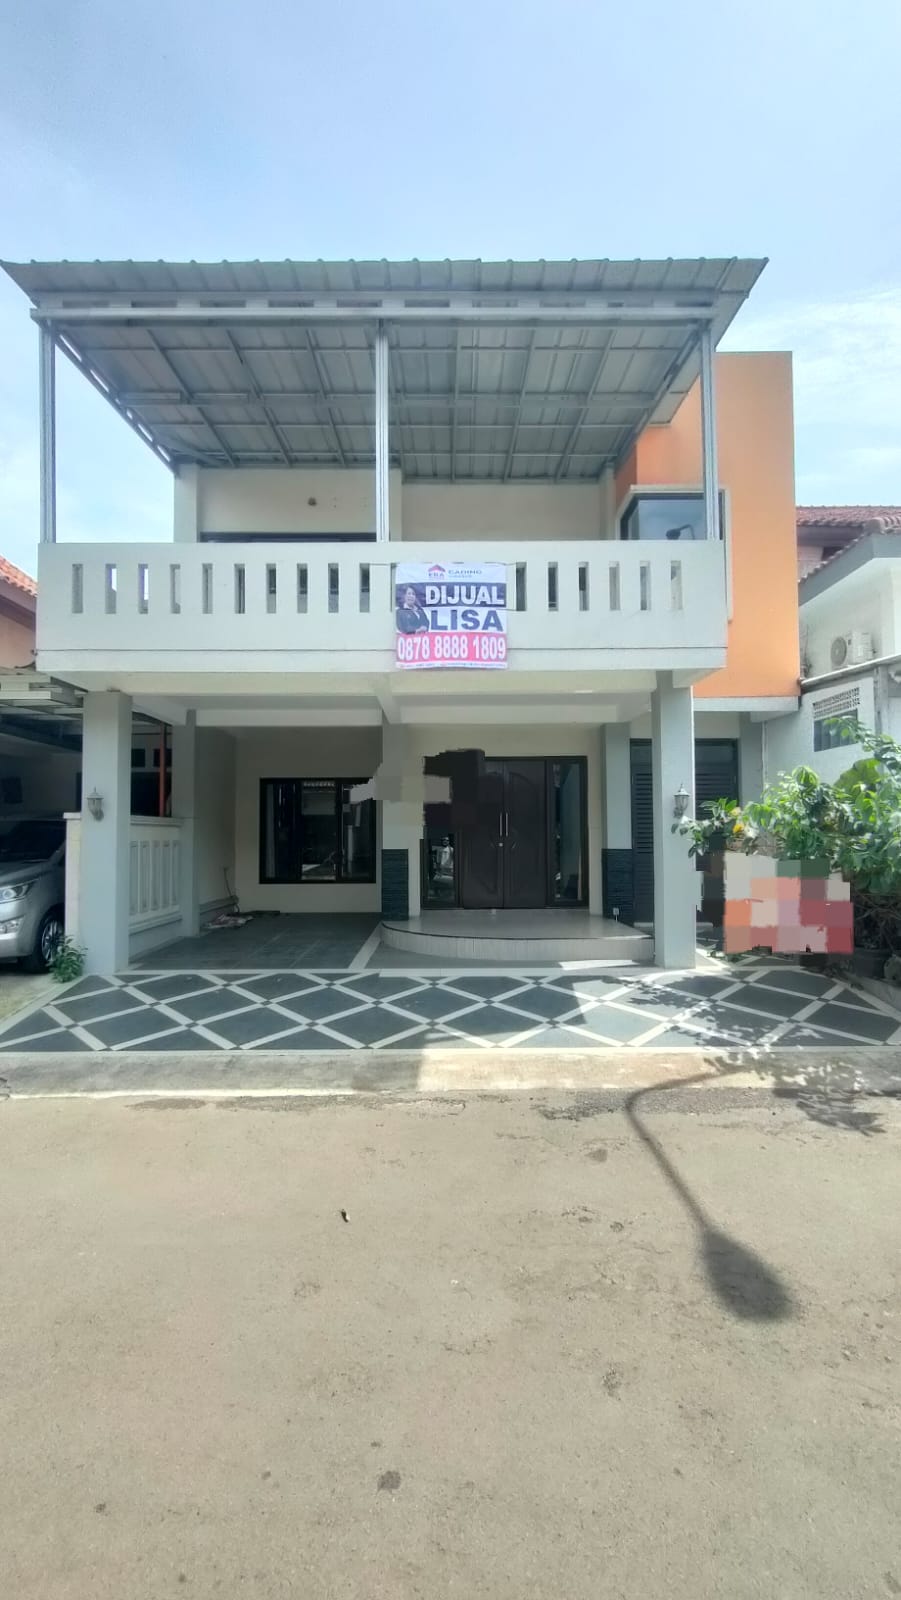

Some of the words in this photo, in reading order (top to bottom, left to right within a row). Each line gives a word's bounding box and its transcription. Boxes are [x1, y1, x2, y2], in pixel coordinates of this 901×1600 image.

[425, 585, 505, 605] DIJUAL
[430, 609, 504, 631] LISA
[397, 636, 430, 661] 0878
[434, 635, 468, 659] 8888
[473, 636, 506, 660] 1809
